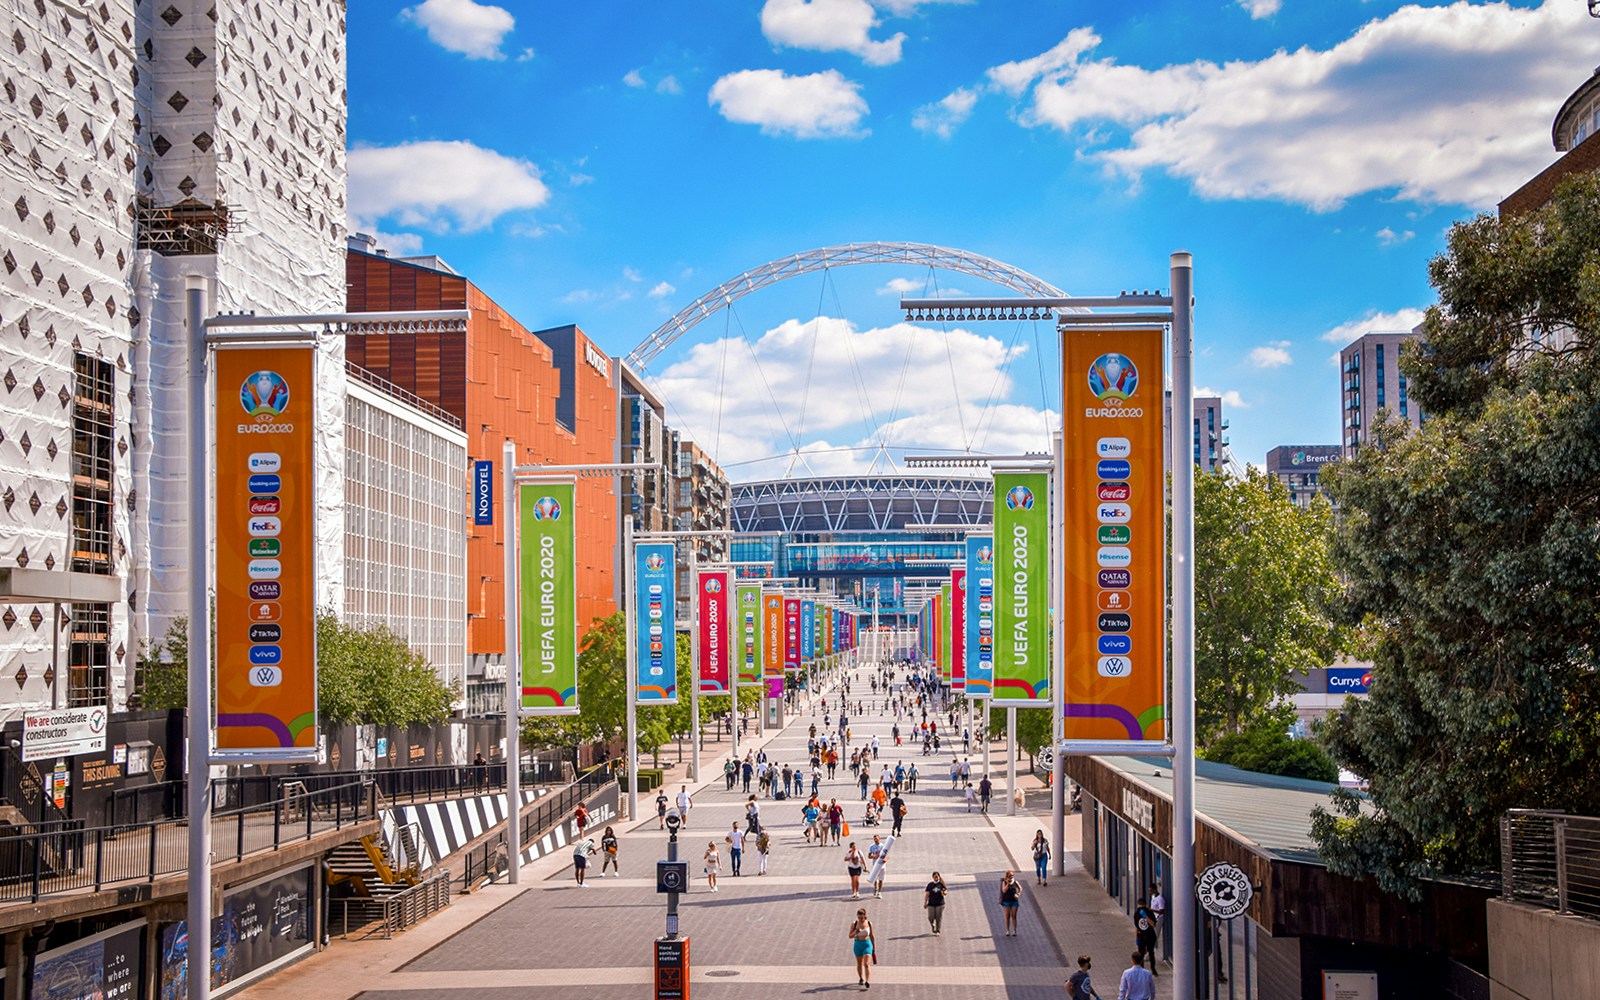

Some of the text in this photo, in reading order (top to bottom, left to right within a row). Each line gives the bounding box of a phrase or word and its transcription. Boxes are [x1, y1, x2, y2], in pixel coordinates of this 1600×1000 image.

[1108, 444, 1127, 453] Alipay
[260, 460, 278, 468] Alipay
[1306, 455, 1329, 463] Brent
[479, 465, 489, 517] NOVOTEL
[1101, 509, 1127, 518] FedEx
[252, 522, 278, 531] FedEx
[1101, 535, 1128, 543] Heineken
[1100, 573, 1127, 582] QATAR
[251, 584, 278, 593] QATAR
[1013, 526, 1028, 665] UEFA EURO 2020
[541, 536, 555, 674] UEFA EURO 2020
[709, 600, 718, 673] UEFA EURO 2020
[485, 663, 507, 680] NOVOTE
[1330, 676, 1361, 688] Currys
[26, 712, 88, 728] We are considerate
[26, 728, 67, 741] constructors
[82, 768, 96, 783] THIS
[1201, 868, 1243, 895] BLACK SHEEP
[1221, 901, 1244, 915] COFFEE
[241, 915, 257, 928] future
[240, 931, 247, 941] is
[107, 967, 130, 983] where
[107, 988, 118, 999] we
[119, 982, 131, 993] are
